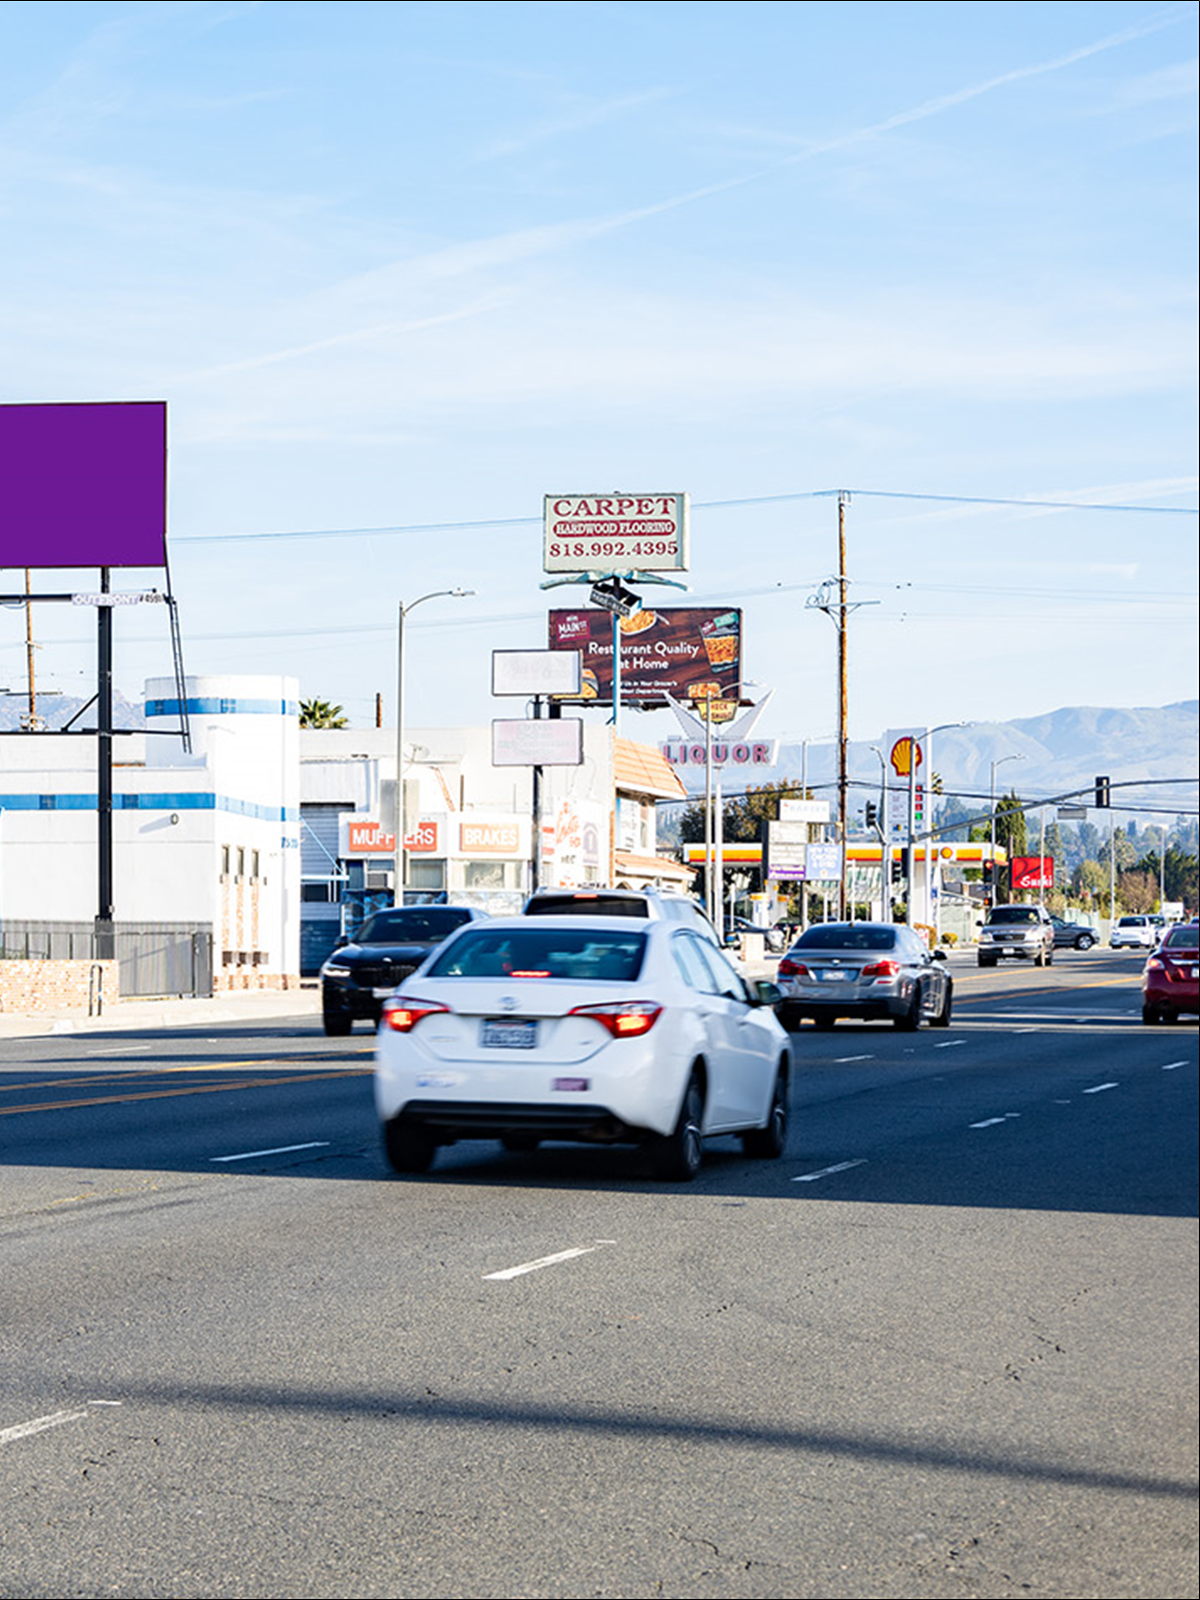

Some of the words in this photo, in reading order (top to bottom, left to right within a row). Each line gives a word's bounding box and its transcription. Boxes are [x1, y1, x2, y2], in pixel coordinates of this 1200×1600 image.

[553, 497, 676, 517] CARPET
[556, 522, 618, 536] HARDWOOD
[620, 520, 674, 535] FLOORING
[550, 540, 678, 558] 818.992.4395
[588, 641, 651, 654] Resturant
[654, 641, 699, 658] Quality
[633, 657, 669, 669] Home
[663, 744, 769, 764] LIQUOR
[352, 827, 435, 846] MUFFERS
[464, 828, 517, 846] BRAKES
